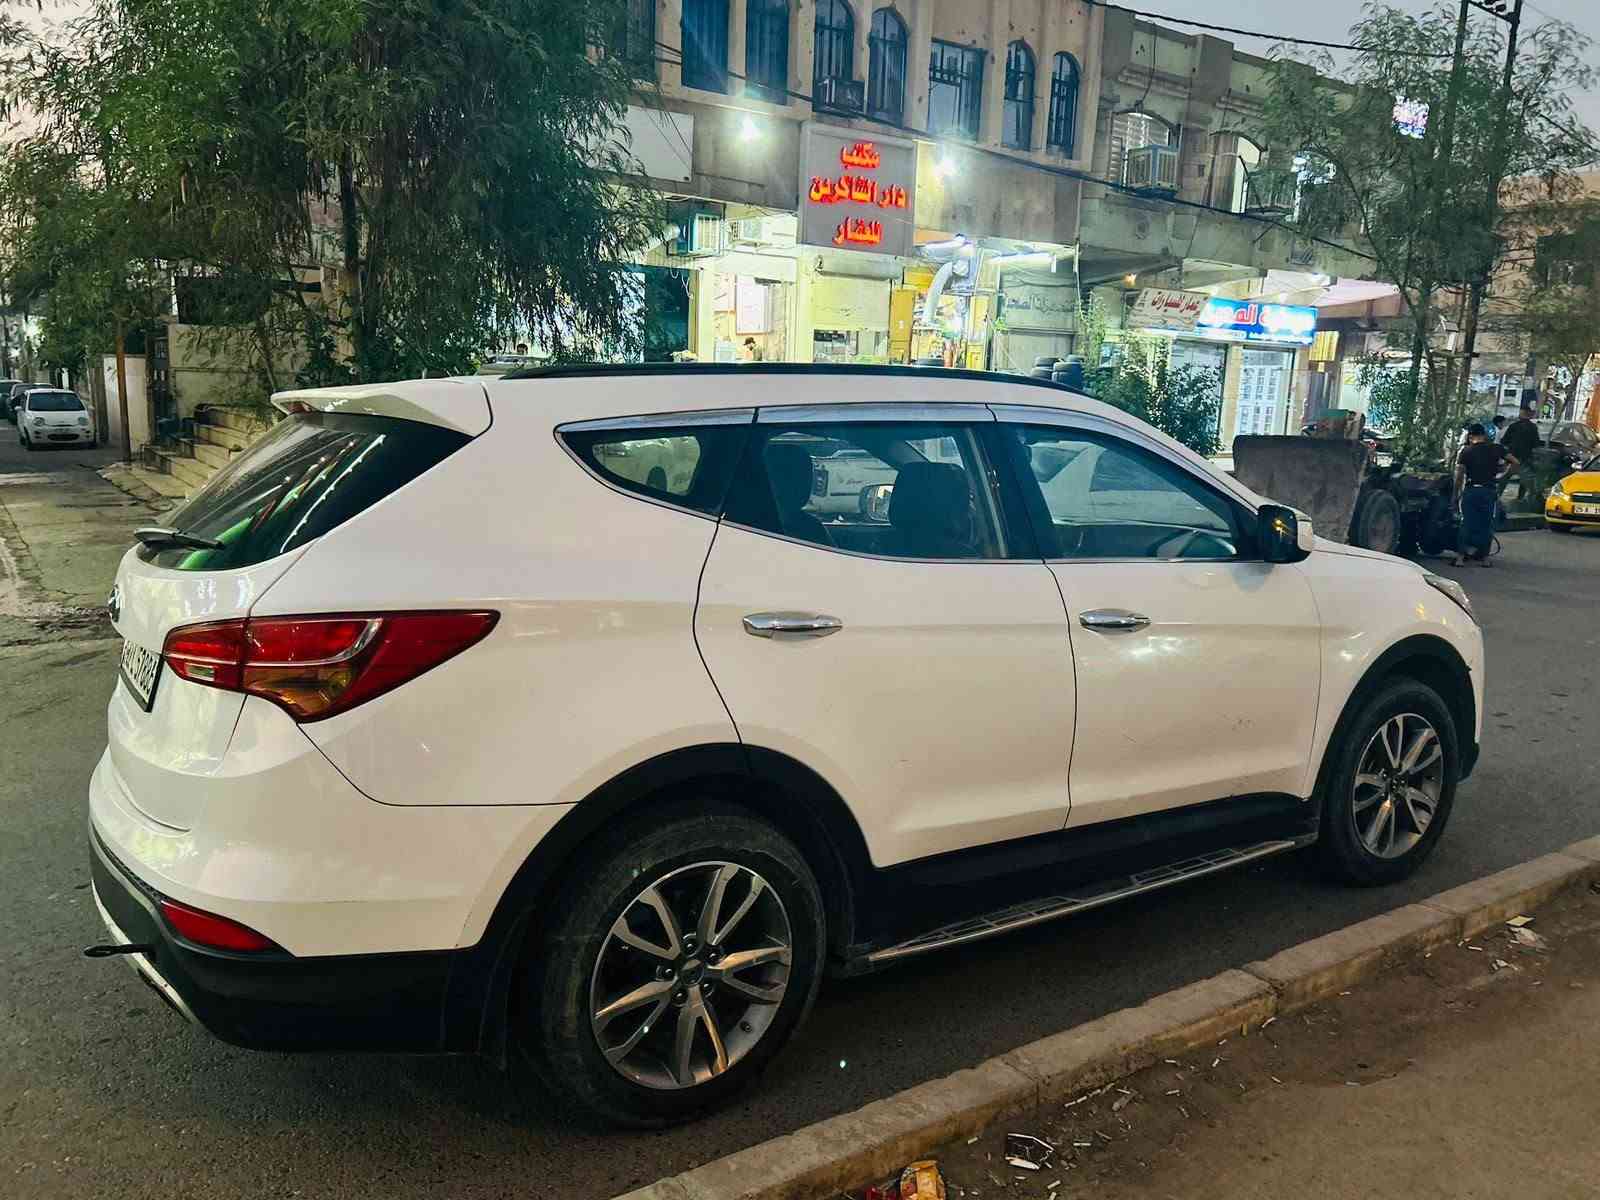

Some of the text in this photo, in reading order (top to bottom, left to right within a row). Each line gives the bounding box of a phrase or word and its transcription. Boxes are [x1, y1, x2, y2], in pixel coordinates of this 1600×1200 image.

[841, 142, 880, 170] مكتب
[809, 175, 907, 209] دار الشاكرين
[832, 216, 881, 246] للعقار
